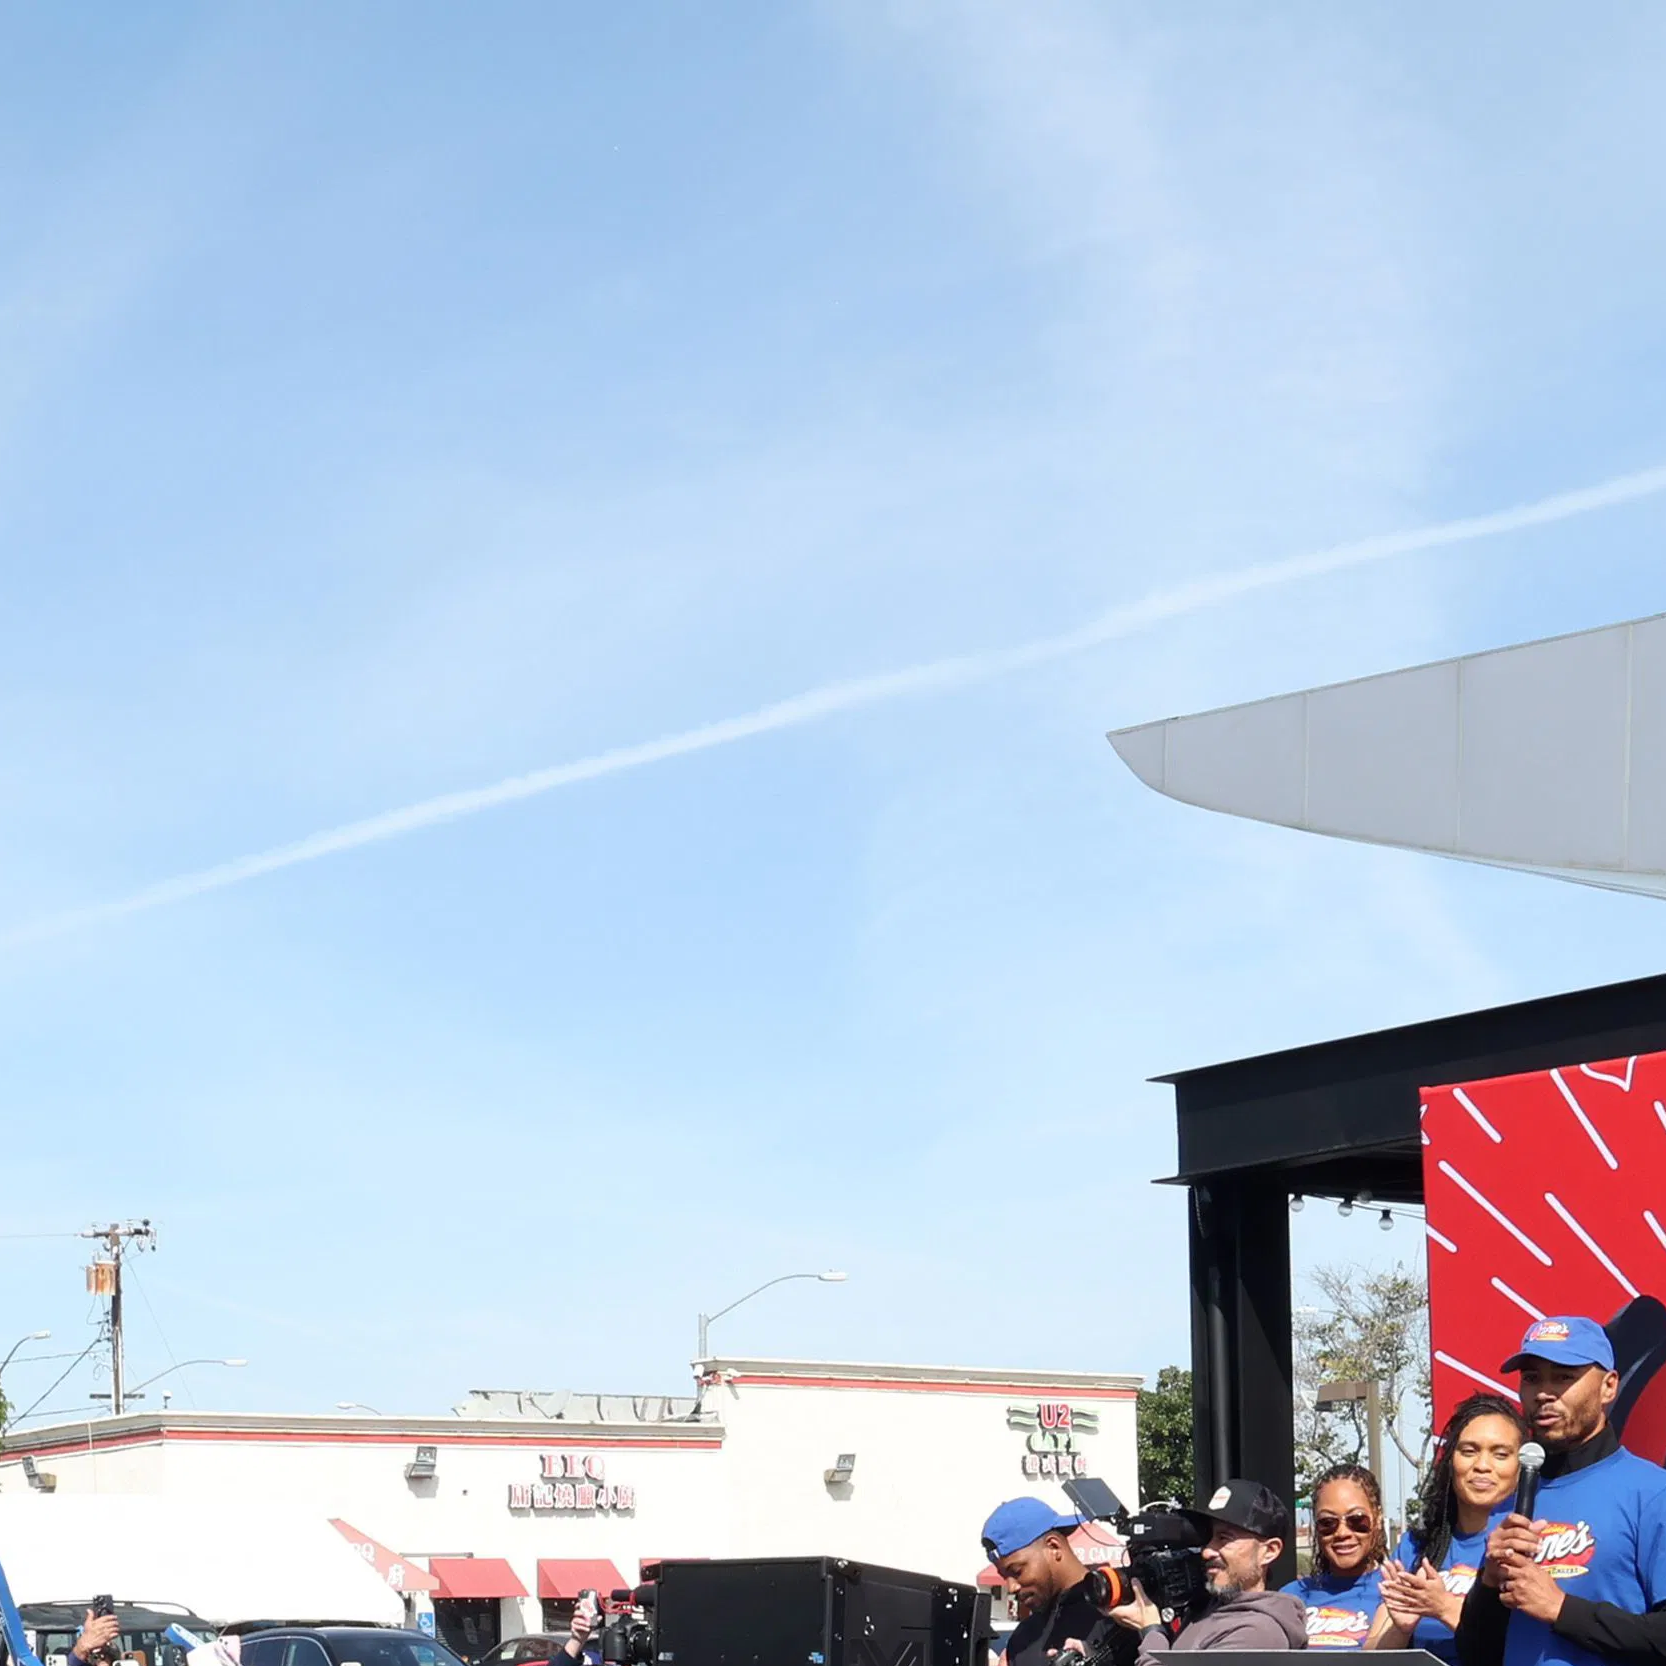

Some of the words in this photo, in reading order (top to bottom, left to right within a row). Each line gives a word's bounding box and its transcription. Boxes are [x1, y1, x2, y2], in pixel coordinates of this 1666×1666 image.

[1039, 1403, 1071, 1429] U2
[540, 1454, 605, 1480] BBQ
[1534, 1520, 1595, 1563] ne's
